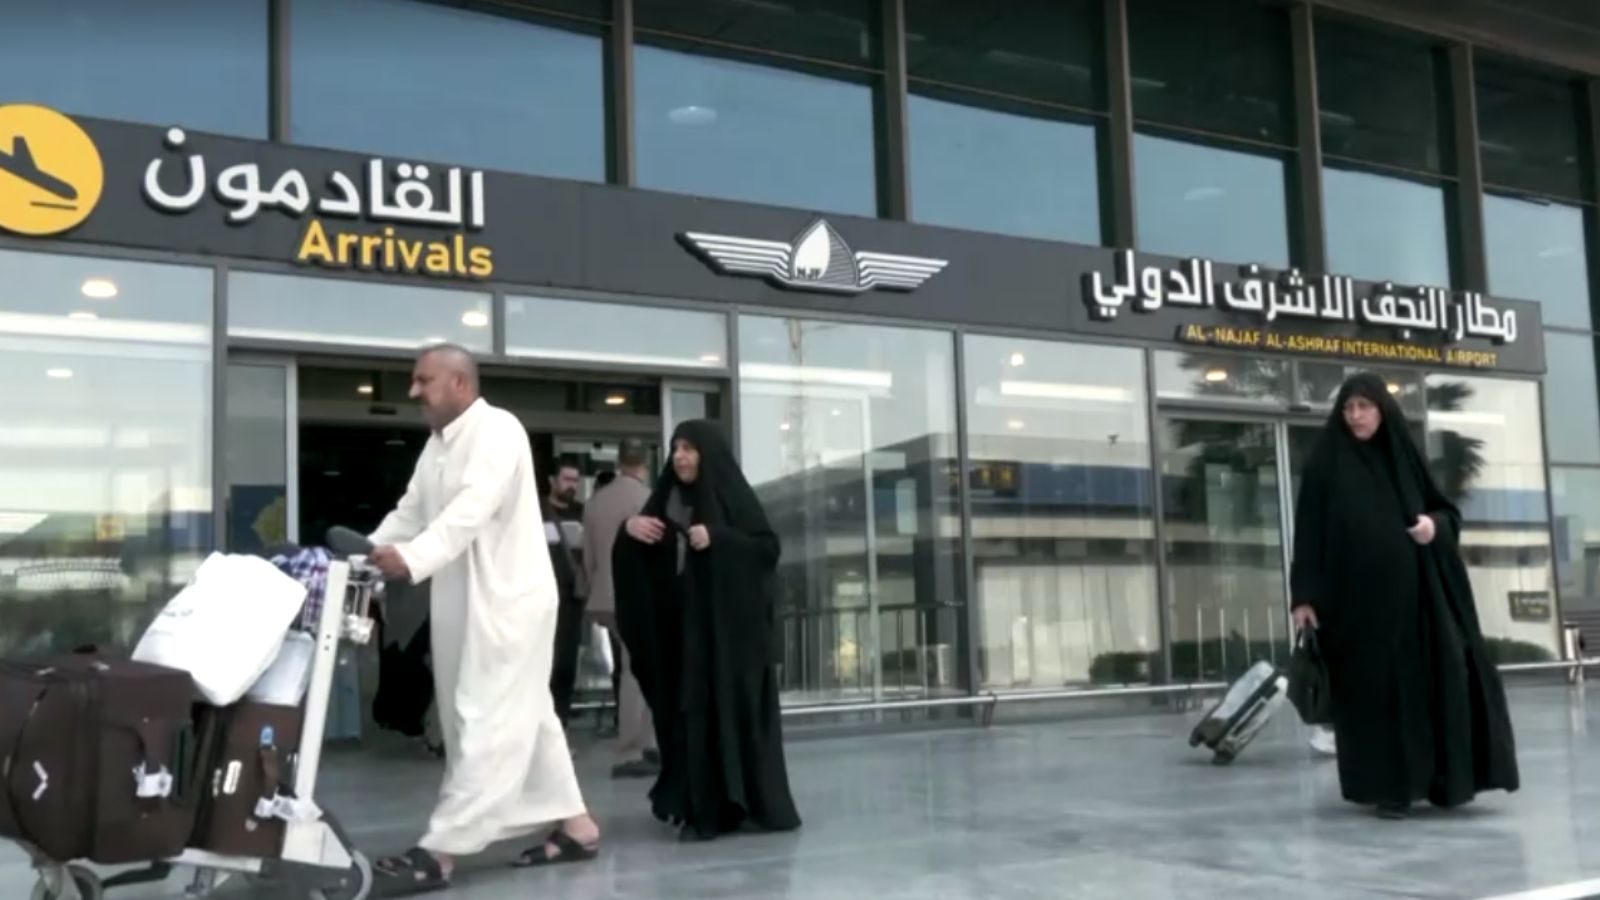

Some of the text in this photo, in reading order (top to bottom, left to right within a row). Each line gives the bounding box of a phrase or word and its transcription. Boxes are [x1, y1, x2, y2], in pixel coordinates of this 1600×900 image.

[144, 127, 484, 227] القادمون
[299, 220, 493, 276] Arrivals
[1092, 249, 1517, 342] مطار النجف الاشرف الدولي
[1266, 332, 1341, 353] AL-ASHRAF
[1342, 340, 1441, 362] INTERNATIONAL
[1446, 349, 1497, 367] AIRPORT
